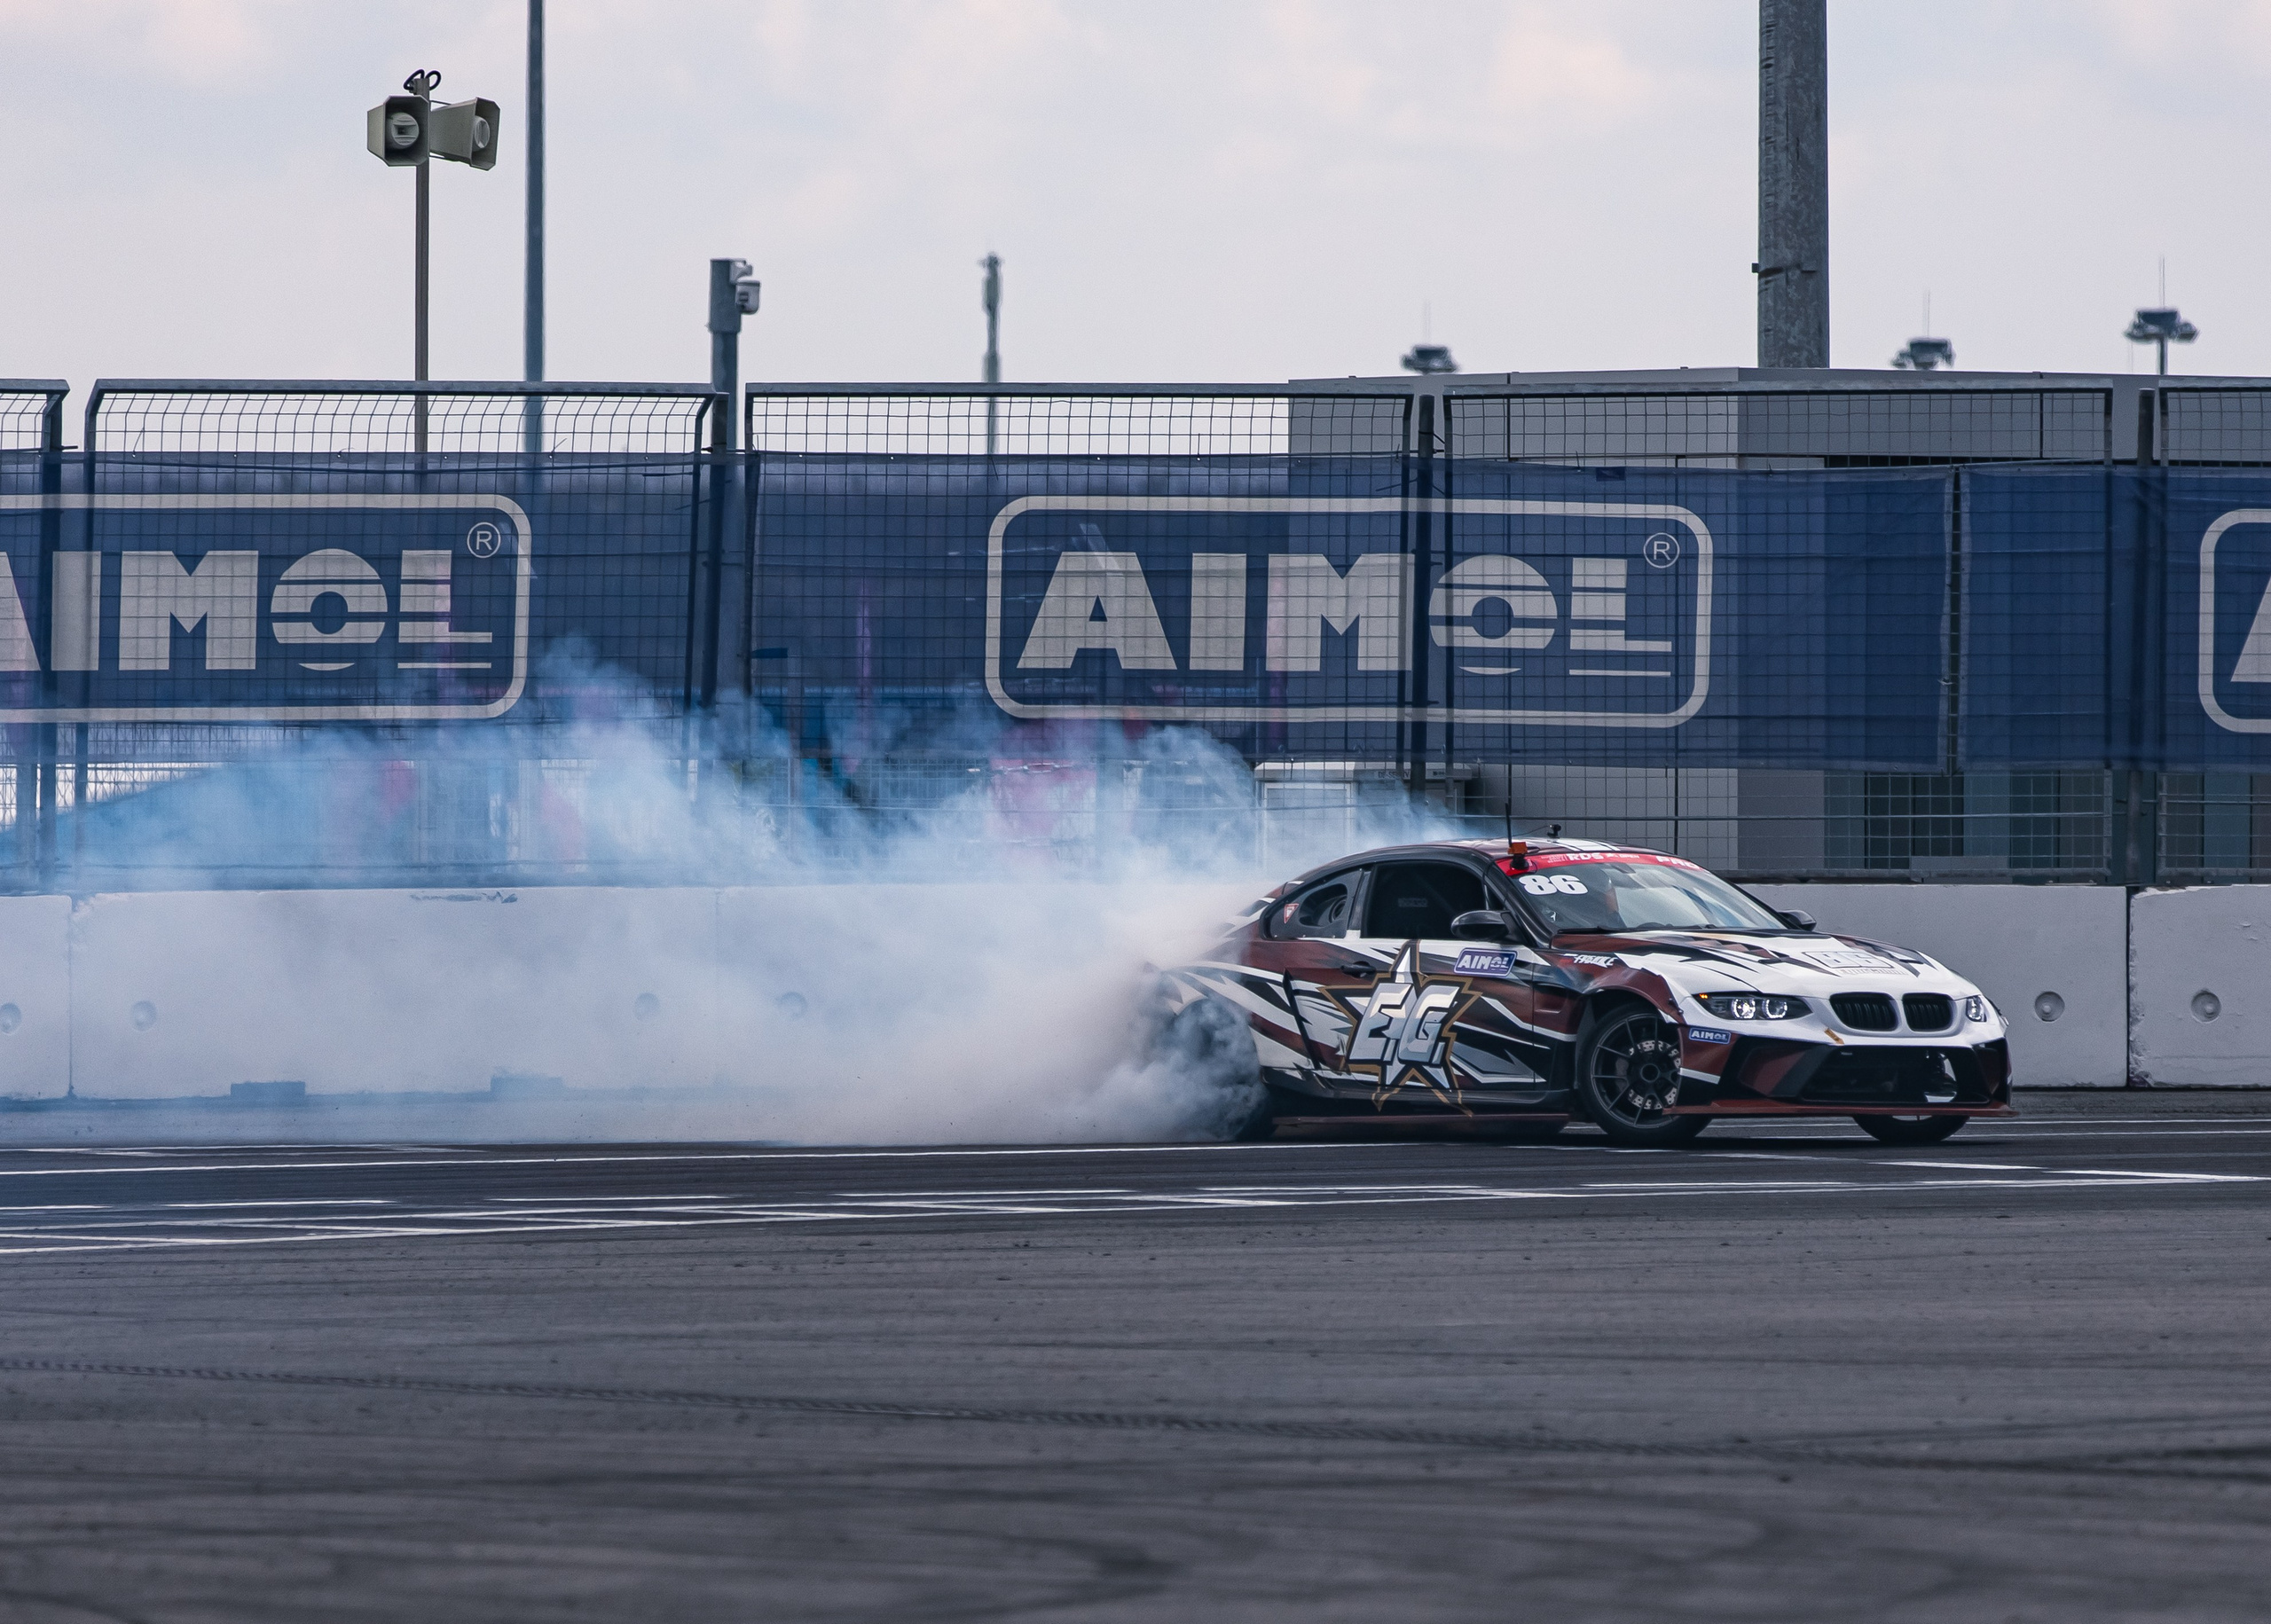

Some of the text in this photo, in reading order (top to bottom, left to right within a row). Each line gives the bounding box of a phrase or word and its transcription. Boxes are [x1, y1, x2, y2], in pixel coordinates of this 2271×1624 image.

[0, 548, 493, 671] IMOL
[1017, 551, 1673, 677] AIMOL
[1519, 875, 1588, 895] 86
[1458, 954, 1510, 971] AIMOL
[1691, 1030, 1728, 1041] AIMOL
